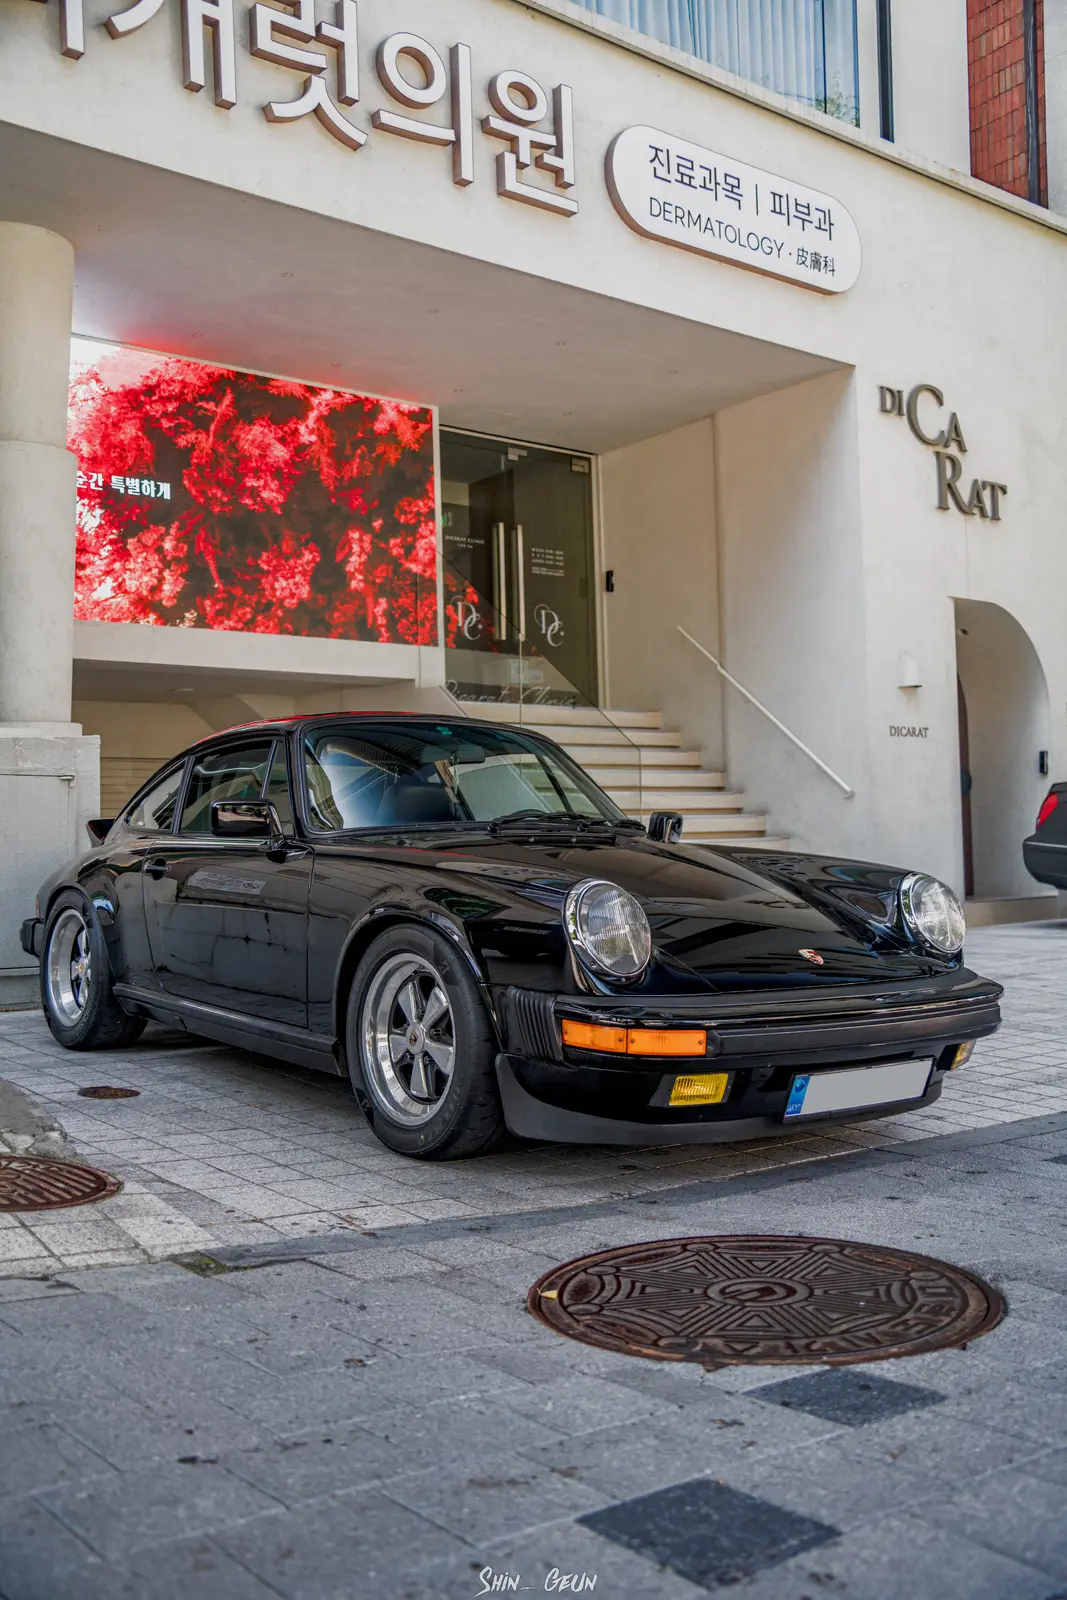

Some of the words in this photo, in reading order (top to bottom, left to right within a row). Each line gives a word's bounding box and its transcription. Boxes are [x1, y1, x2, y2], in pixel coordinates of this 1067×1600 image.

[28, 0, 579, 217] 럿의원
[649, 144, 744, 211] 진료과목
[770, 191, 835, 242] 피부과
[649, 196, 785, 259] DERMATOLOGY
[796, 246, 836, 278] 皮膚科
[110, 475, 172, 500] 특별하게
[888, 725, 930, 739] DICARAT
